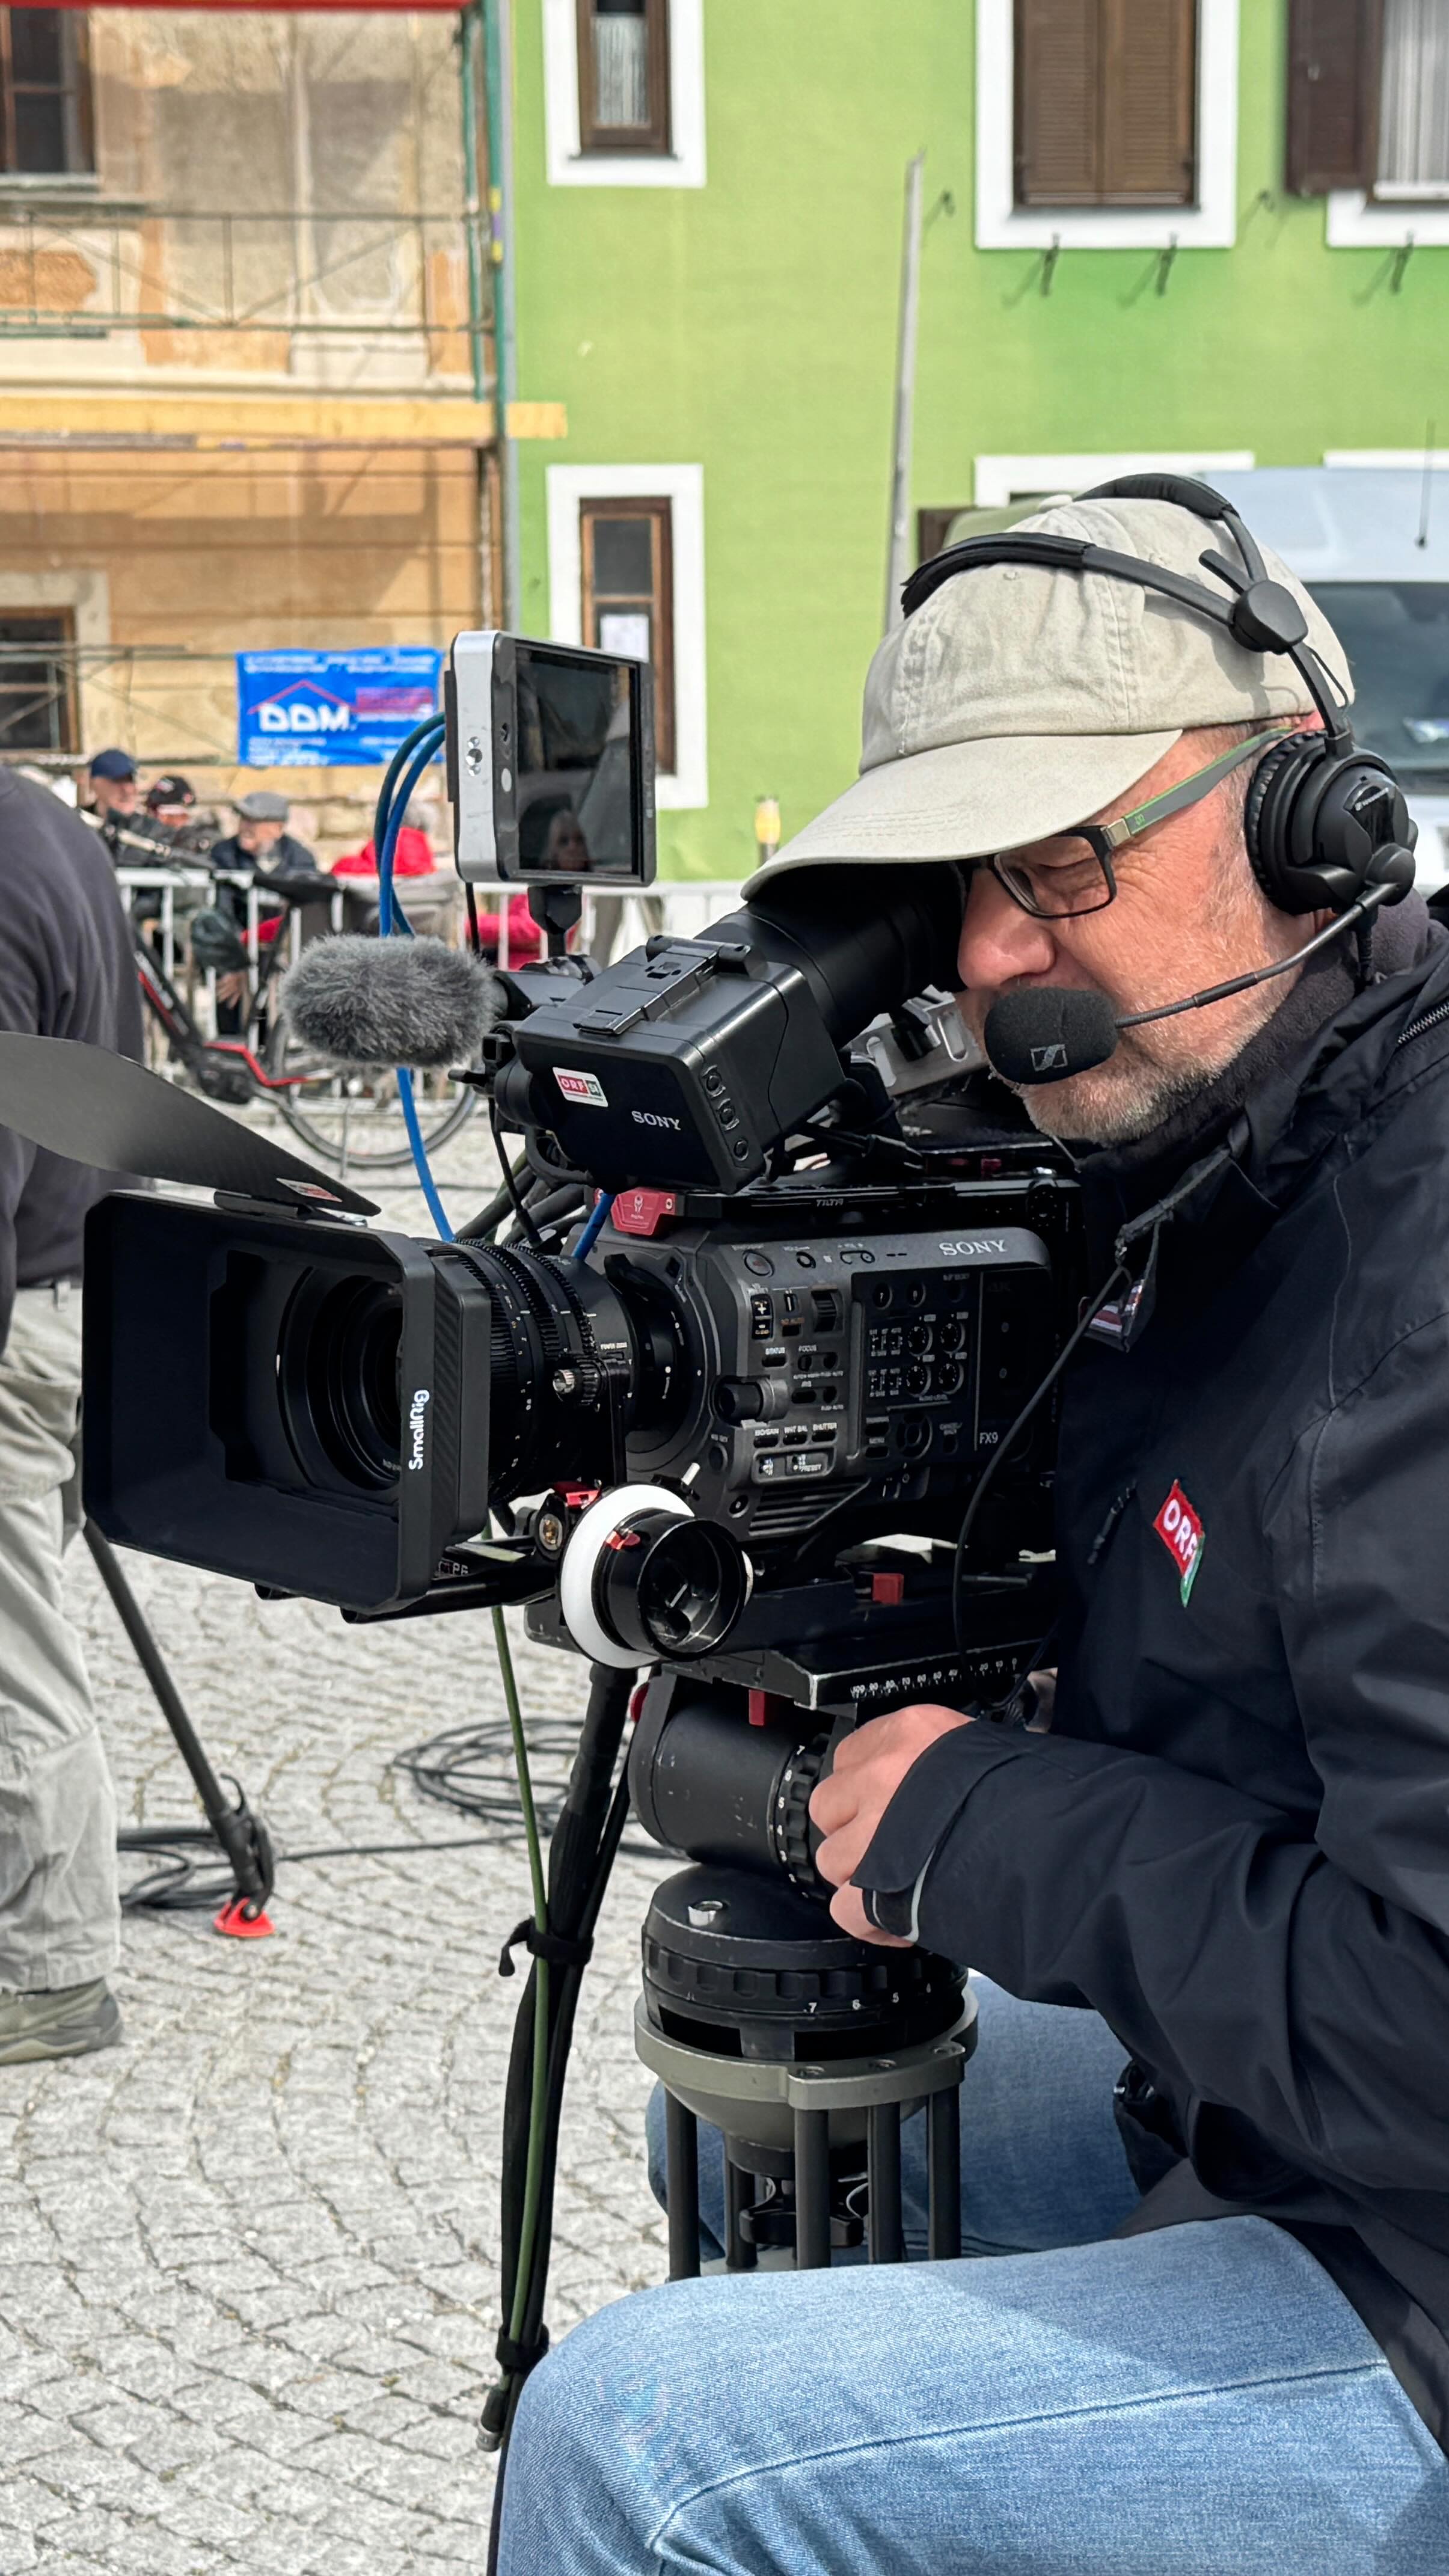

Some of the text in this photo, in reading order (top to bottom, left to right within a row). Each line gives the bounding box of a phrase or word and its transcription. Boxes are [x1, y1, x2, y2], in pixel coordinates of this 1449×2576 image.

[560, 1077, 588, 1091] ORF
[631, 1111, 681, 1130] SONY
[939, 1240, 1007, 1256] SONY
[408, 1390, 430, 1470] SmallRig
[979, 1432, 999, 1444] FX9
[796, 1745, 806, 1755] 7
[778, 1796, 785, 1809] 5
[808, 2002, 817, 2013] 7
[851, 1999, 861, 2010] 6
[892, 1992, 899, 2004] 5
